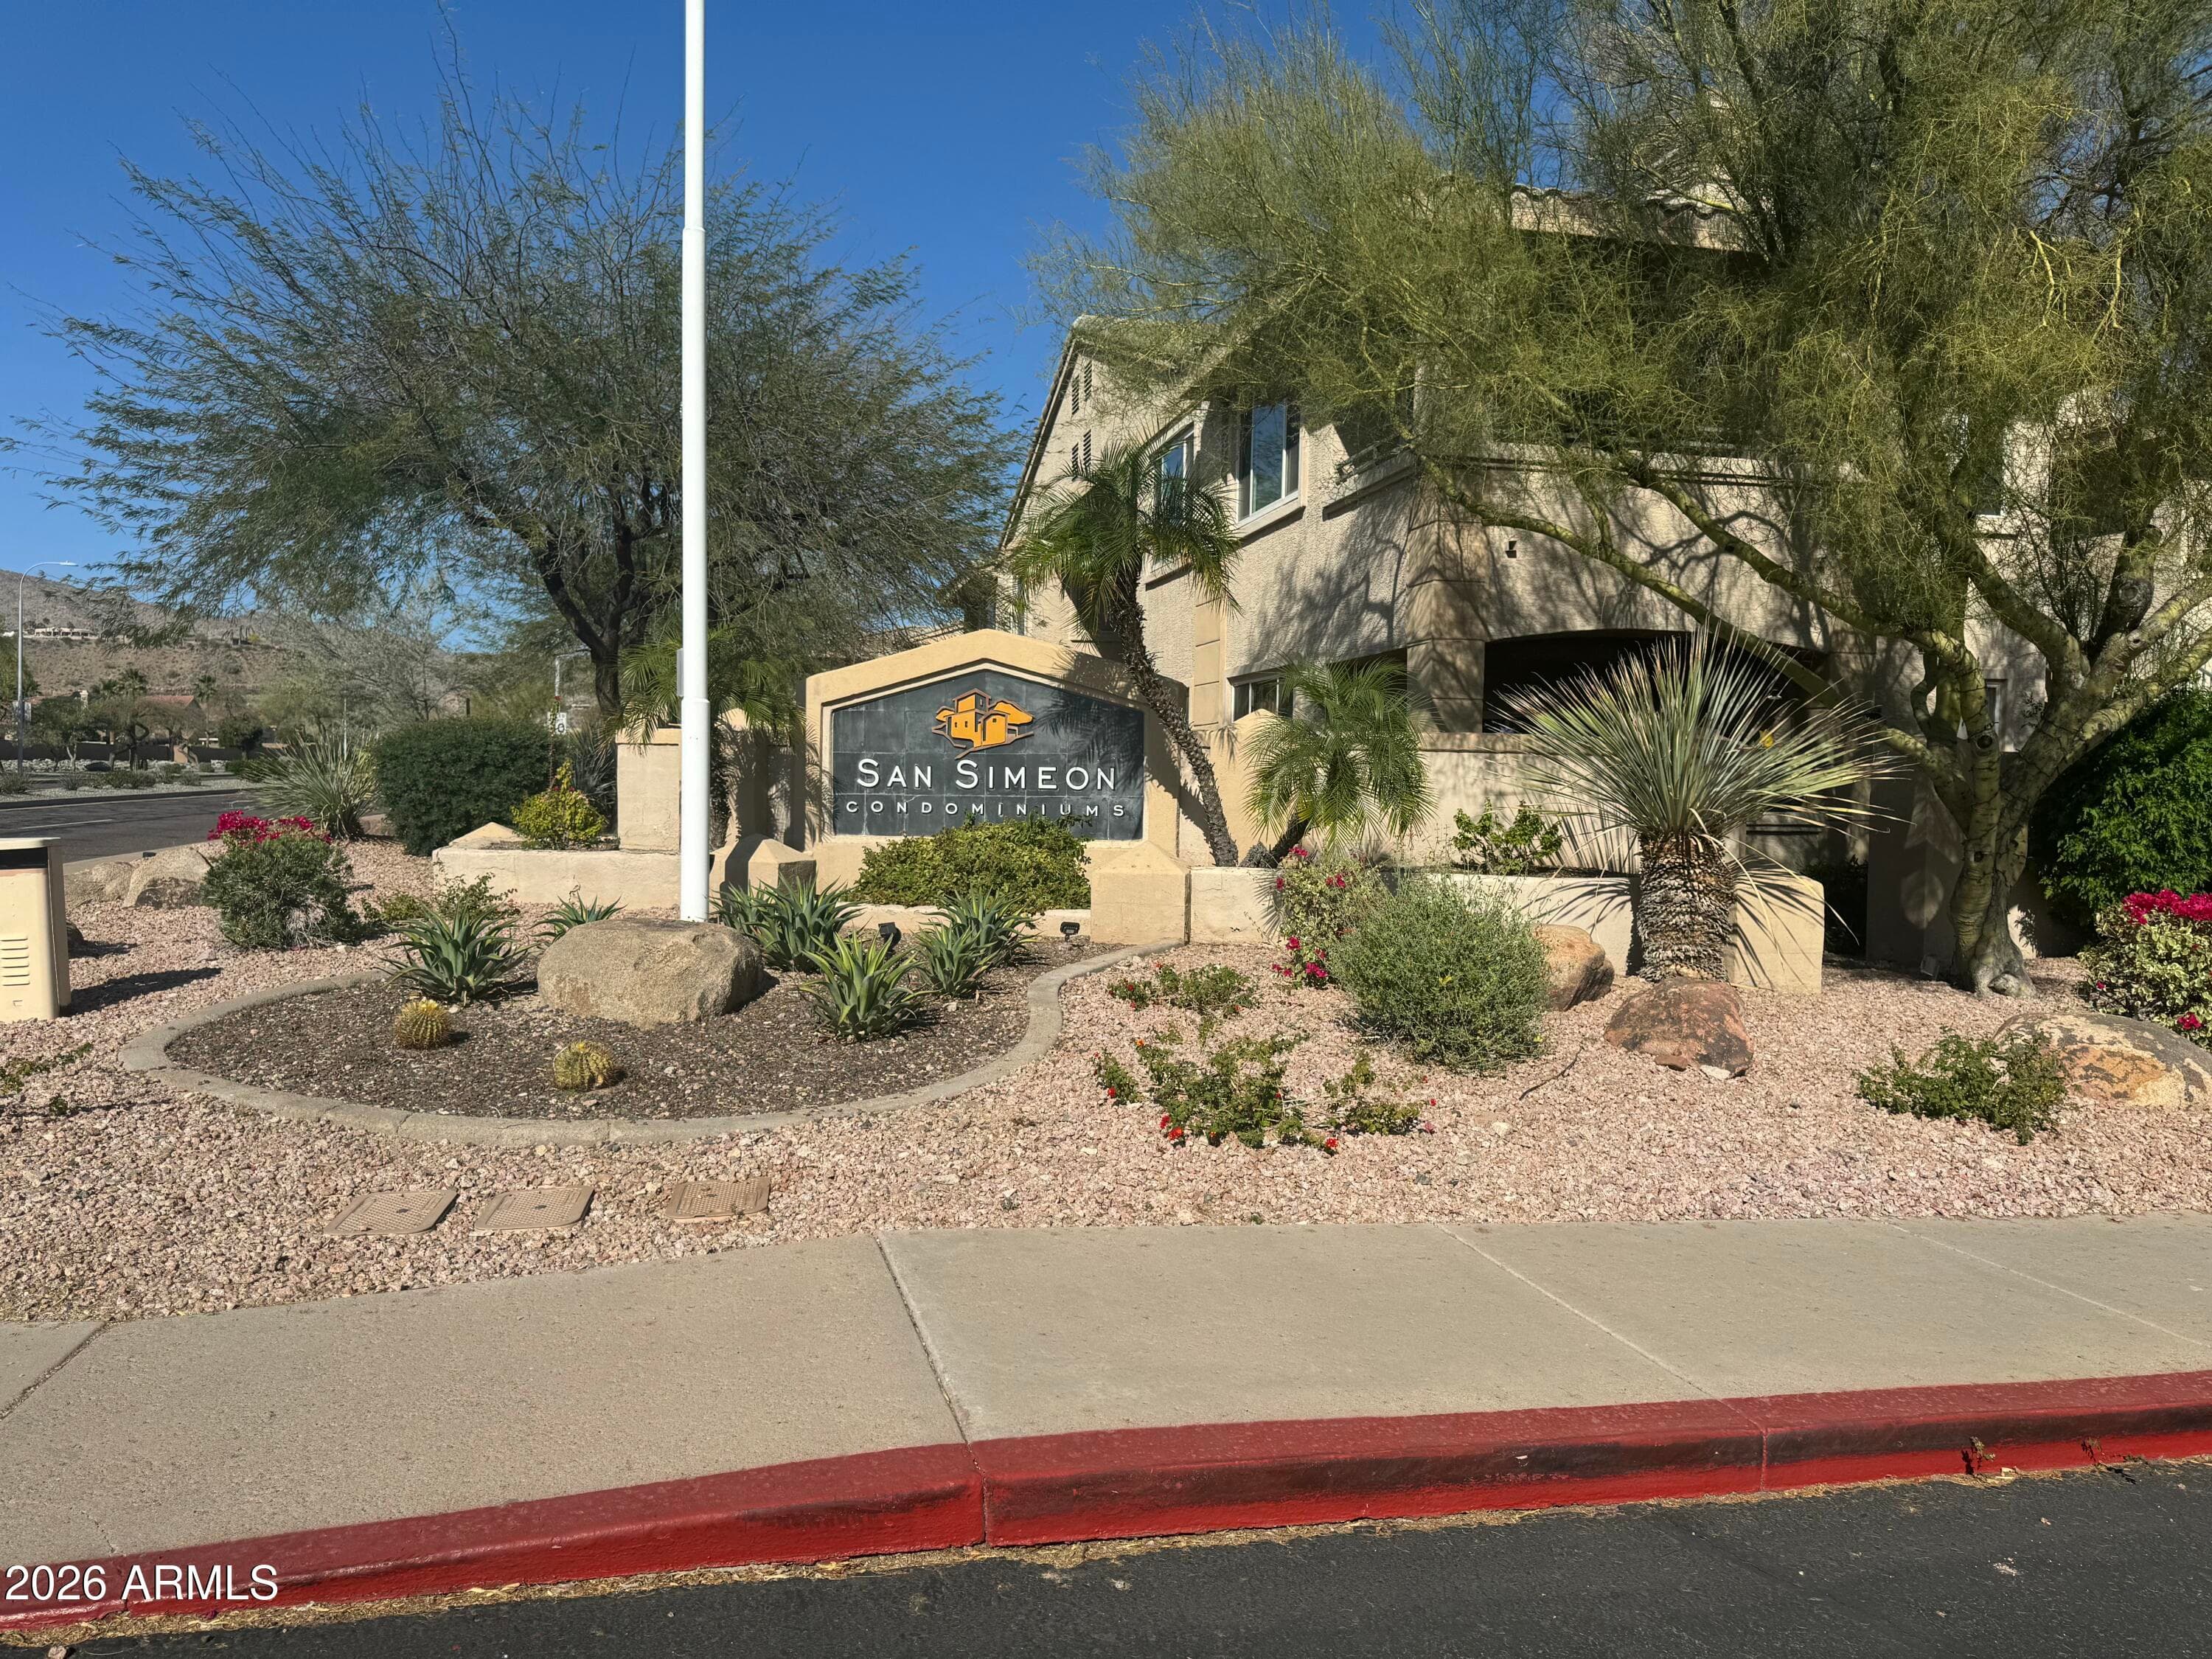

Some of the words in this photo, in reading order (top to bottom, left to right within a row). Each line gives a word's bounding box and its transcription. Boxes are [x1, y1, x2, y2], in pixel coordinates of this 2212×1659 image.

[857, 758, 933, 789] SAN
[956, 759, 1116, 790] SIMEON
[846, 801, 1124, 816] CONDOMINIUMS
